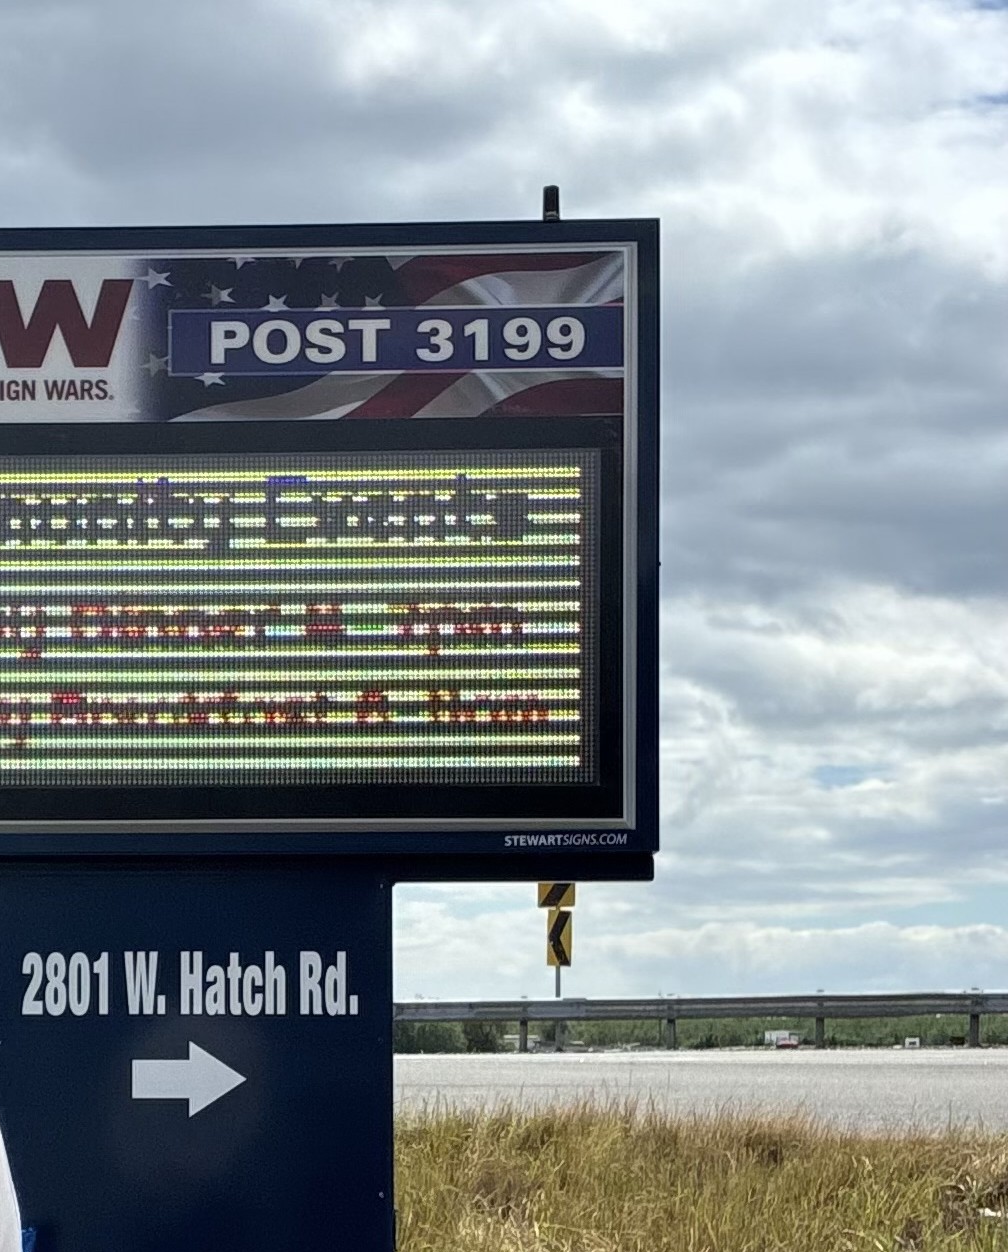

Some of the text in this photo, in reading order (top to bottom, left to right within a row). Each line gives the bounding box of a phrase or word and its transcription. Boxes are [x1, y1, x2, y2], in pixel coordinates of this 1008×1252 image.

[210, 316, 586, 365] POST 3199
[504, 834, 628, 846] STEWARTSIGNS.COM
[22, 951, 359, 1016] 2801 W. Hatch Rd.
